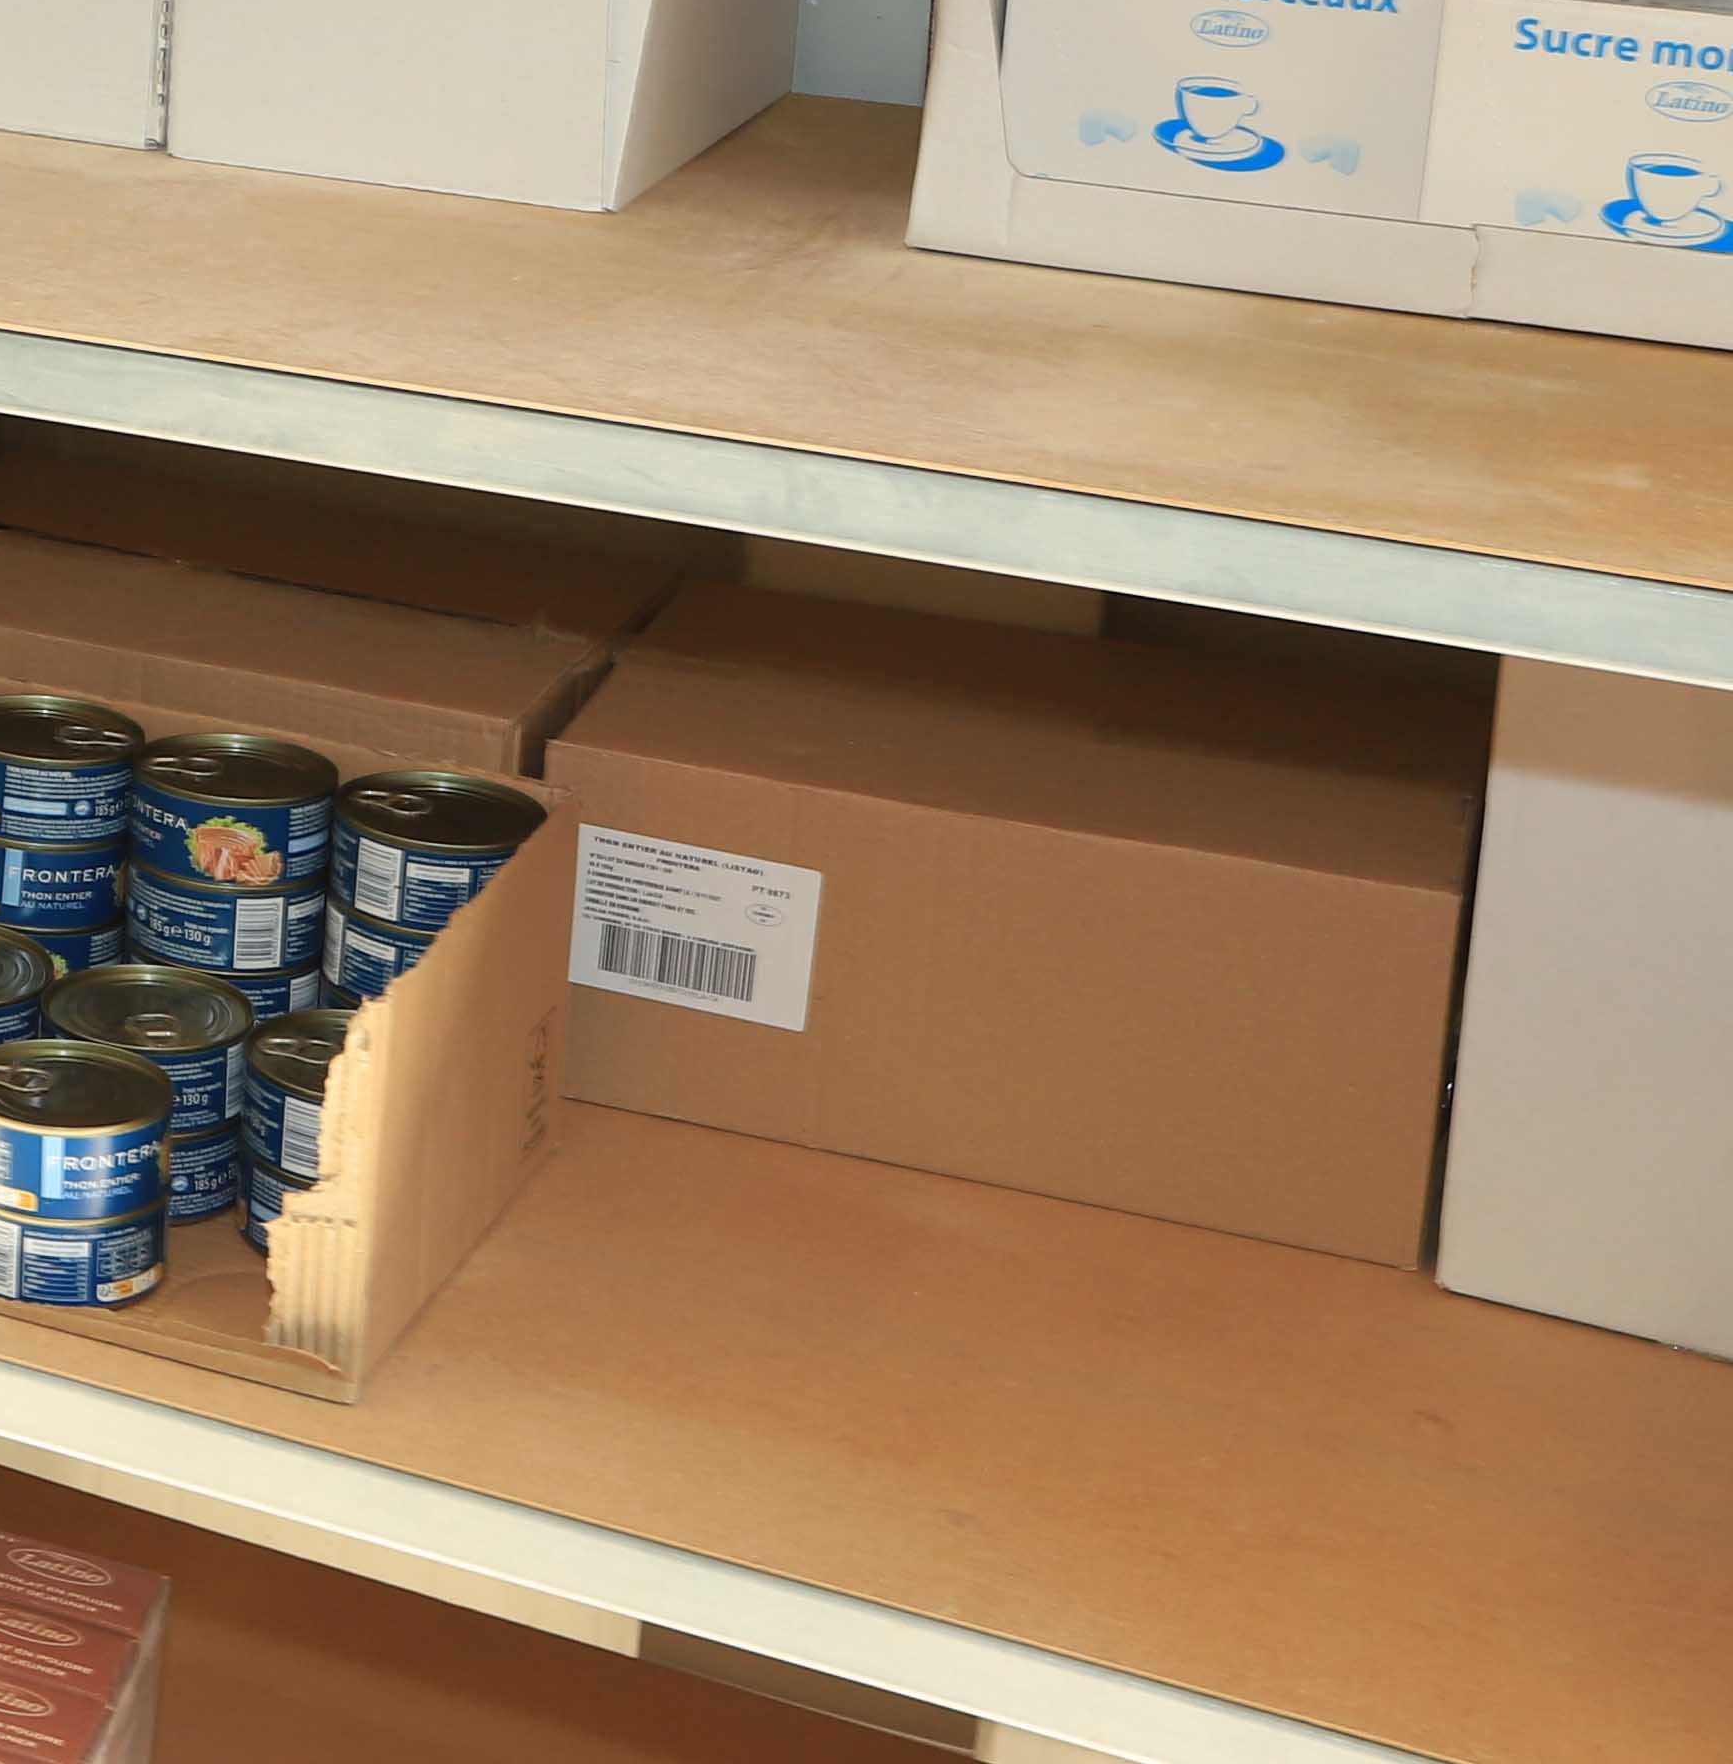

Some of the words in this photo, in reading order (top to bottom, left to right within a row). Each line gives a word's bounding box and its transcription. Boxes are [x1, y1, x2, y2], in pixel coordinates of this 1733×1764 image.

[1197, 13, 1265, 41] Latino
[1513, 18, 1640, 63] Sucre
[622, 840, 657, 855] ENTIER
[659, 850, 672, 859] AU
[675, 852, 720, 868] NATUREL
[8, 864, 115, 883] FRONTERA
[21, 891, 52, 900] THON
[54, 891, 92, 901] ENTIER
[38, 901, 84, 909] NATUREL
[184, 929, 202, 941] 130
[183, 1094, 200, 1106] 130
[47, 1140, 160, 1171] FRONTERA
[194, 1178, 210, 1190] 185
